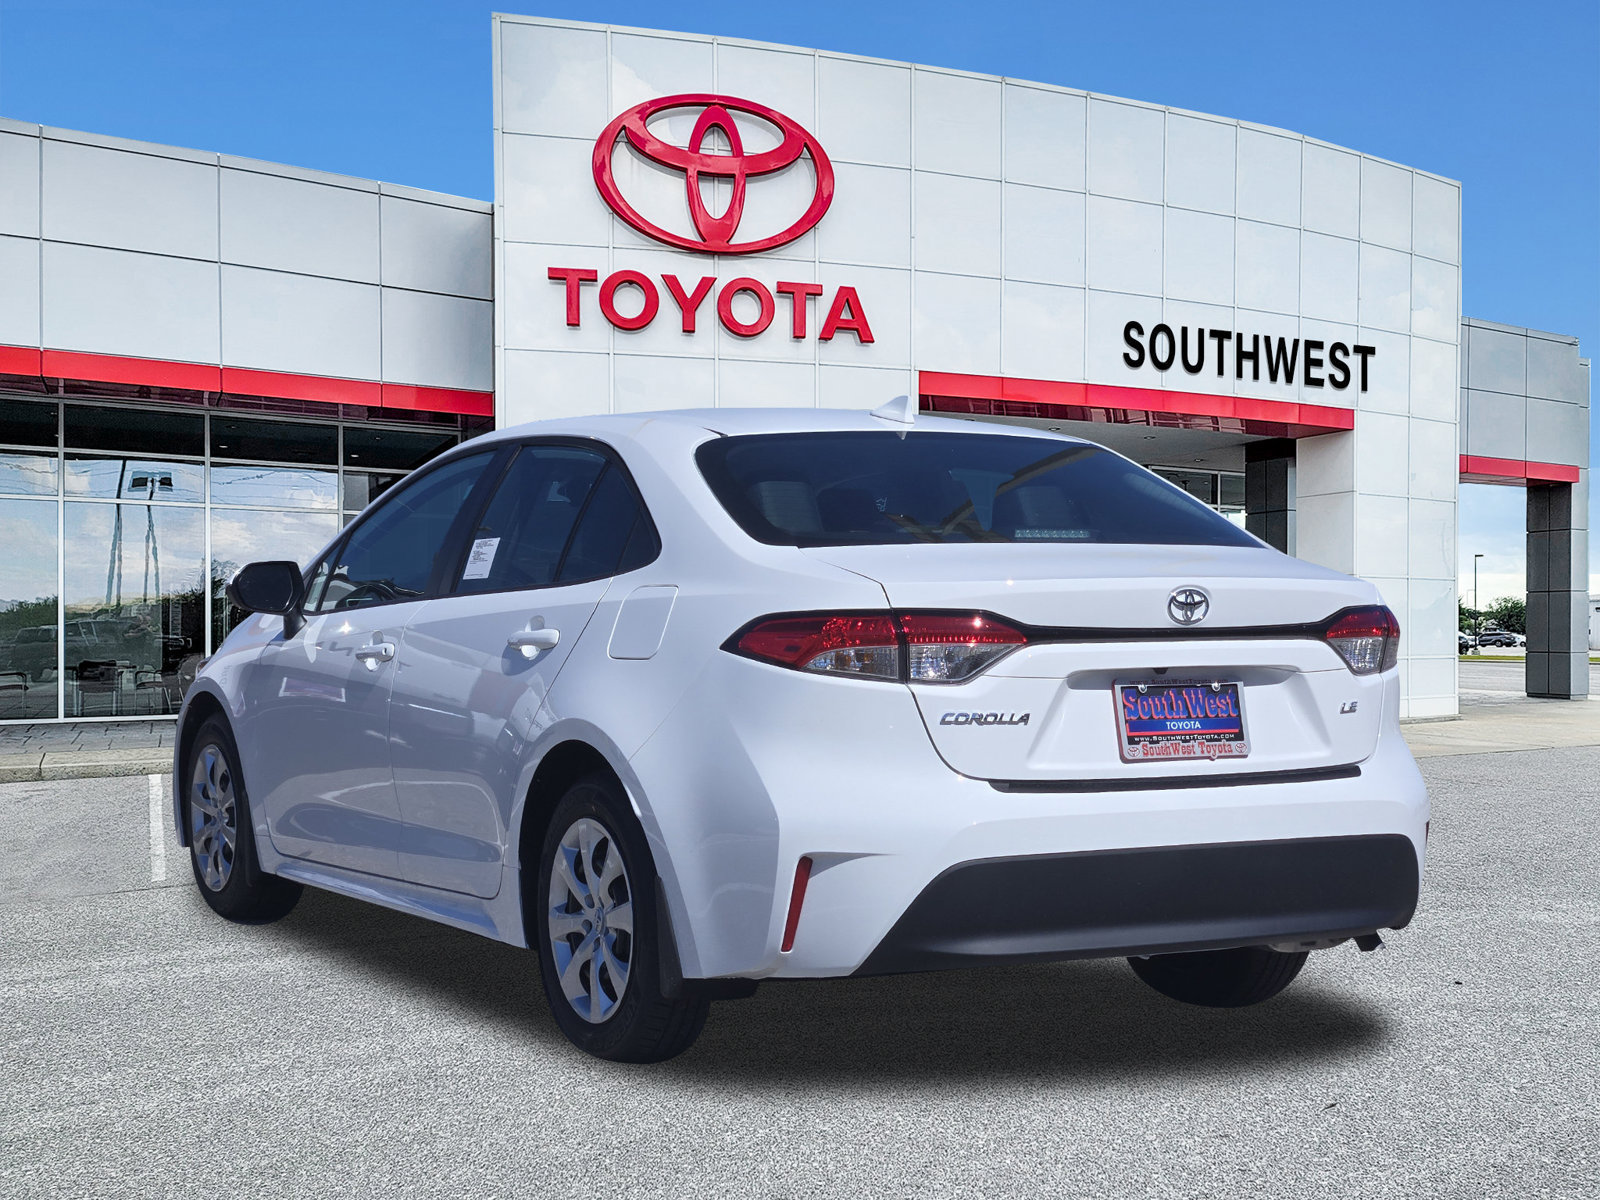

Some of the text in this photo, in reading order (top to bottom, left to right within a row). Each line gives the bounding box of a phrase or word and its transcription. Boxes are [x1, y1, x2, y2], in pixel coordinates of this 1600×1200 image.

[548, 267, 875, 343] TOYOTA
[1123, 320, 1376, 392] SOUTHWEST
[1122, 688, 1238, 720] SouthWest
[1340, 701, 1358, 714] LE
[940, 712, 1030, 726] COROLLA
[1165, 721, 1202, 730] TOYOTA
[1141, 740, 1233, 758] SouthWest Toyota
